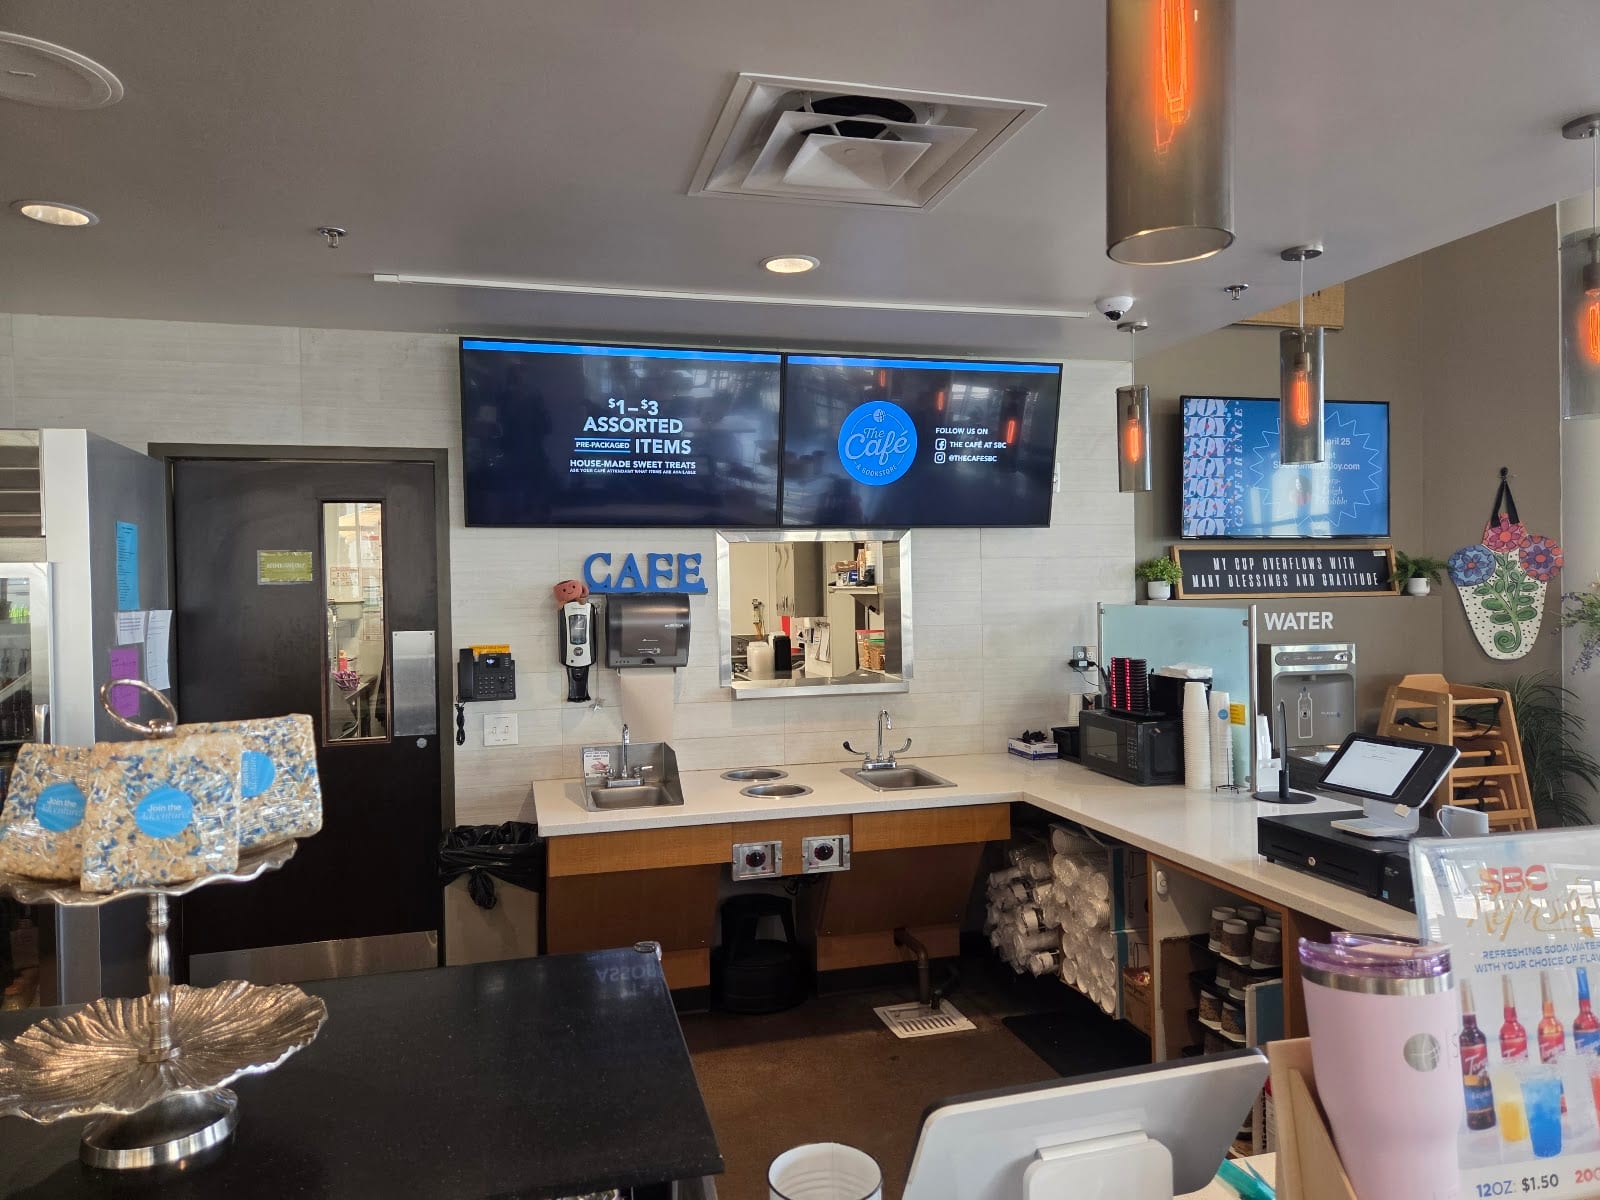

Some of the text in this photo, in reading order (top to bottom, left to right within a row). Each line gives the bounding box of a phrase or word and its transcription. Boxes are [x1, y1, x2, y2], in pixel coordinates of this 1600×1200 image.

[583, 416, 683, 434] ASSORTED
[863, 427, 885, 438] The
[575, 438, 692, 455] PRE-PACKAGED ITEMS
[844, 430, 911, 466] Café
[983, 441, 992, 449] AT
[1324, 437, 1351, 447] pril 25
[569, 459, 696, 469] HOUSE-MADE SWEET TREATS
[948, 454, 998, 462] @THECAFESBC
[861, 464, 897, 477] BOOKSTORE
[1213, 556, 1355, 571] MY CUP OVERFLOWS WITH
[583, 552, 708, 594] CAFE
[1192, 572, 1379, 588] MANY BLESSINGS AND GRATITUDE
[1264, 611, 1334, 631] WATER
[64, 799, 77, 808] the
[148, 803, 182, 813] Join the
[1479, 864, 1549, 895] SBC
[1482, 945, 1543, 960] REFRESHING
[1544, 944, 1569, 954] SODA
[1474, 963, 1501, 974] WITH
[1502, 960, 1527, 971] YOUR
[1528, 956, 1564, 968] CHOICE
[1565, 955, 1578, 965] OF
[1521, 1174, 1559, 1193] $1.50
